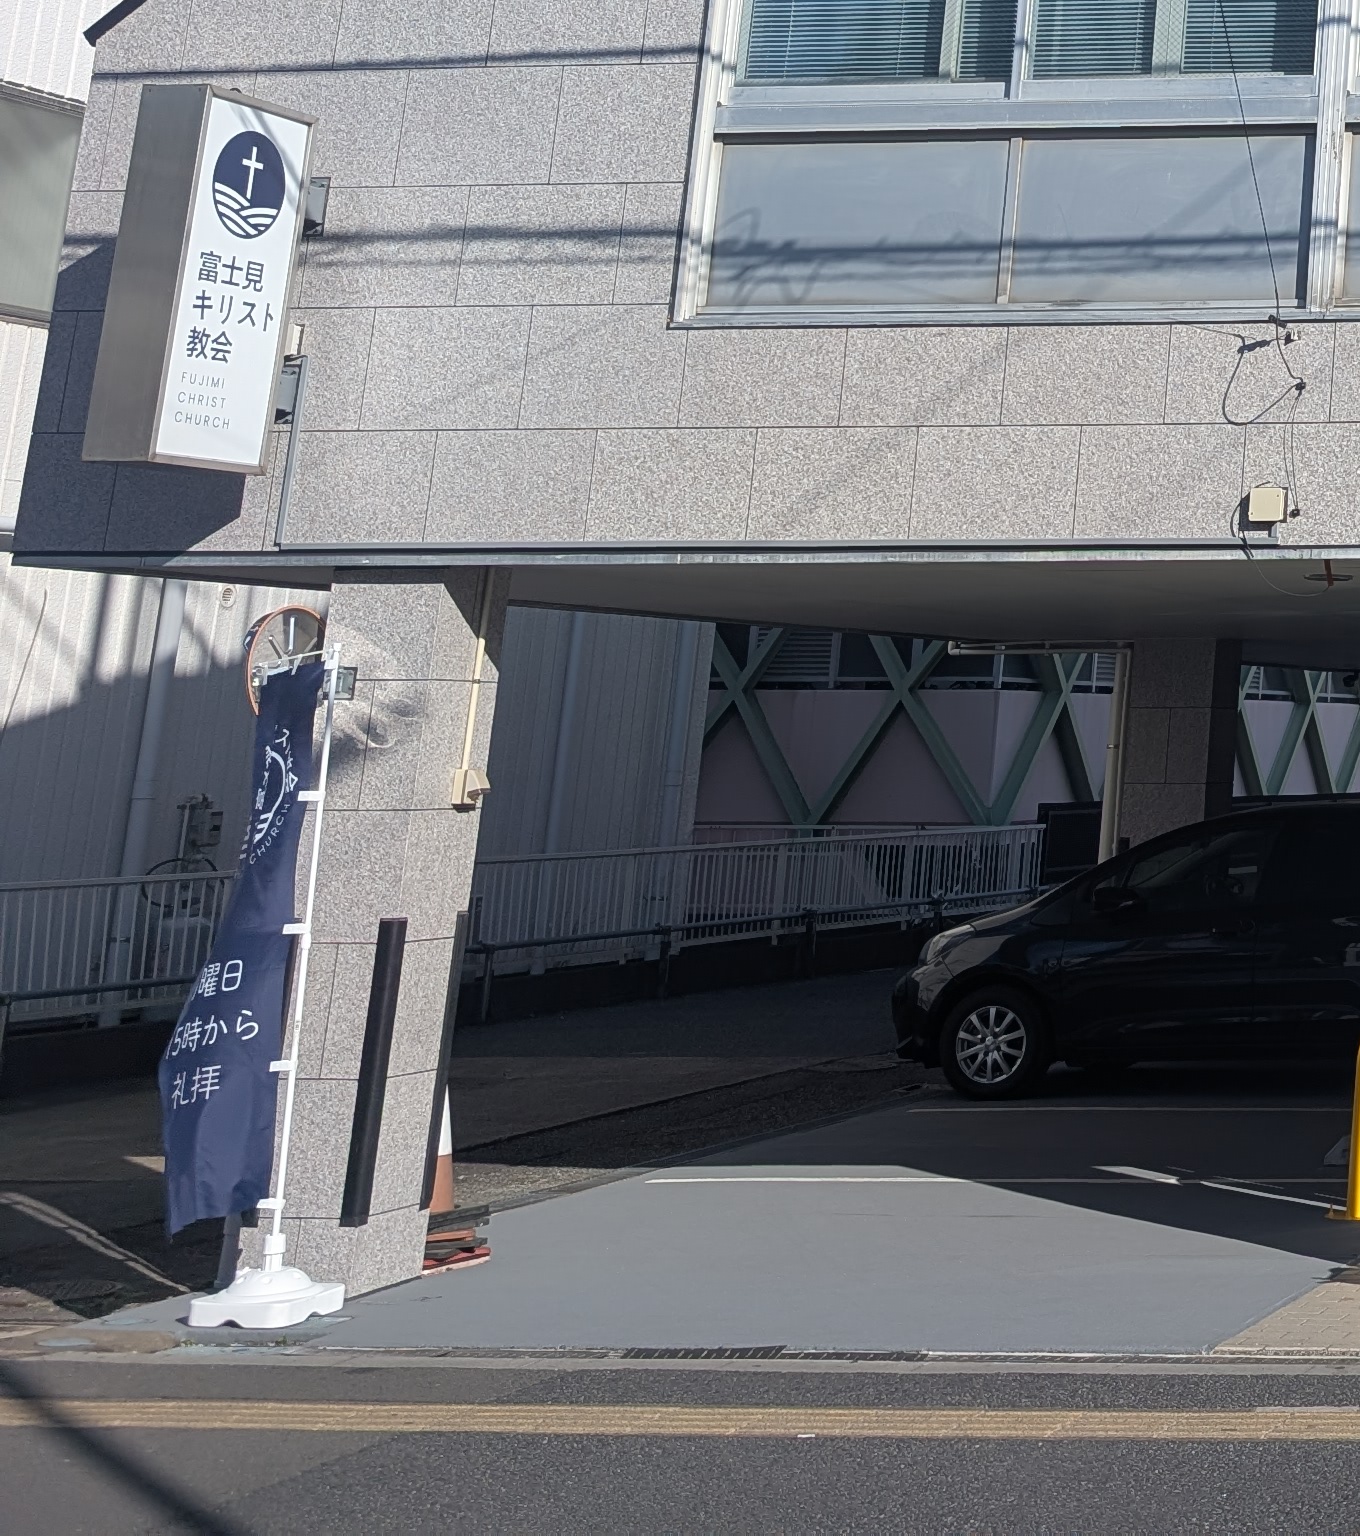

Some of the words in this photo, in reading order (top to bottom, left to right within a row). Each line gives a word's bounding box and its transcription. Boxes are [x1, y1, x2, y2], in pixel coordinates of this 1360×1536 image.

[198, 250, 264, 292] 富士見
[192, 289, 274, 332] キリスト
[186, 326, 232, 363] 教会
[177, 391, 226, 409] CHRIST
[181, 371, 225, 389] FUJIMI
[174, 411, 230, 430] CHURCH
[249, 803, 291, 865] CHURCH
[191, 960, 243, 1001] 曜日
[171, 1064, 222, 1109] 礼拝
